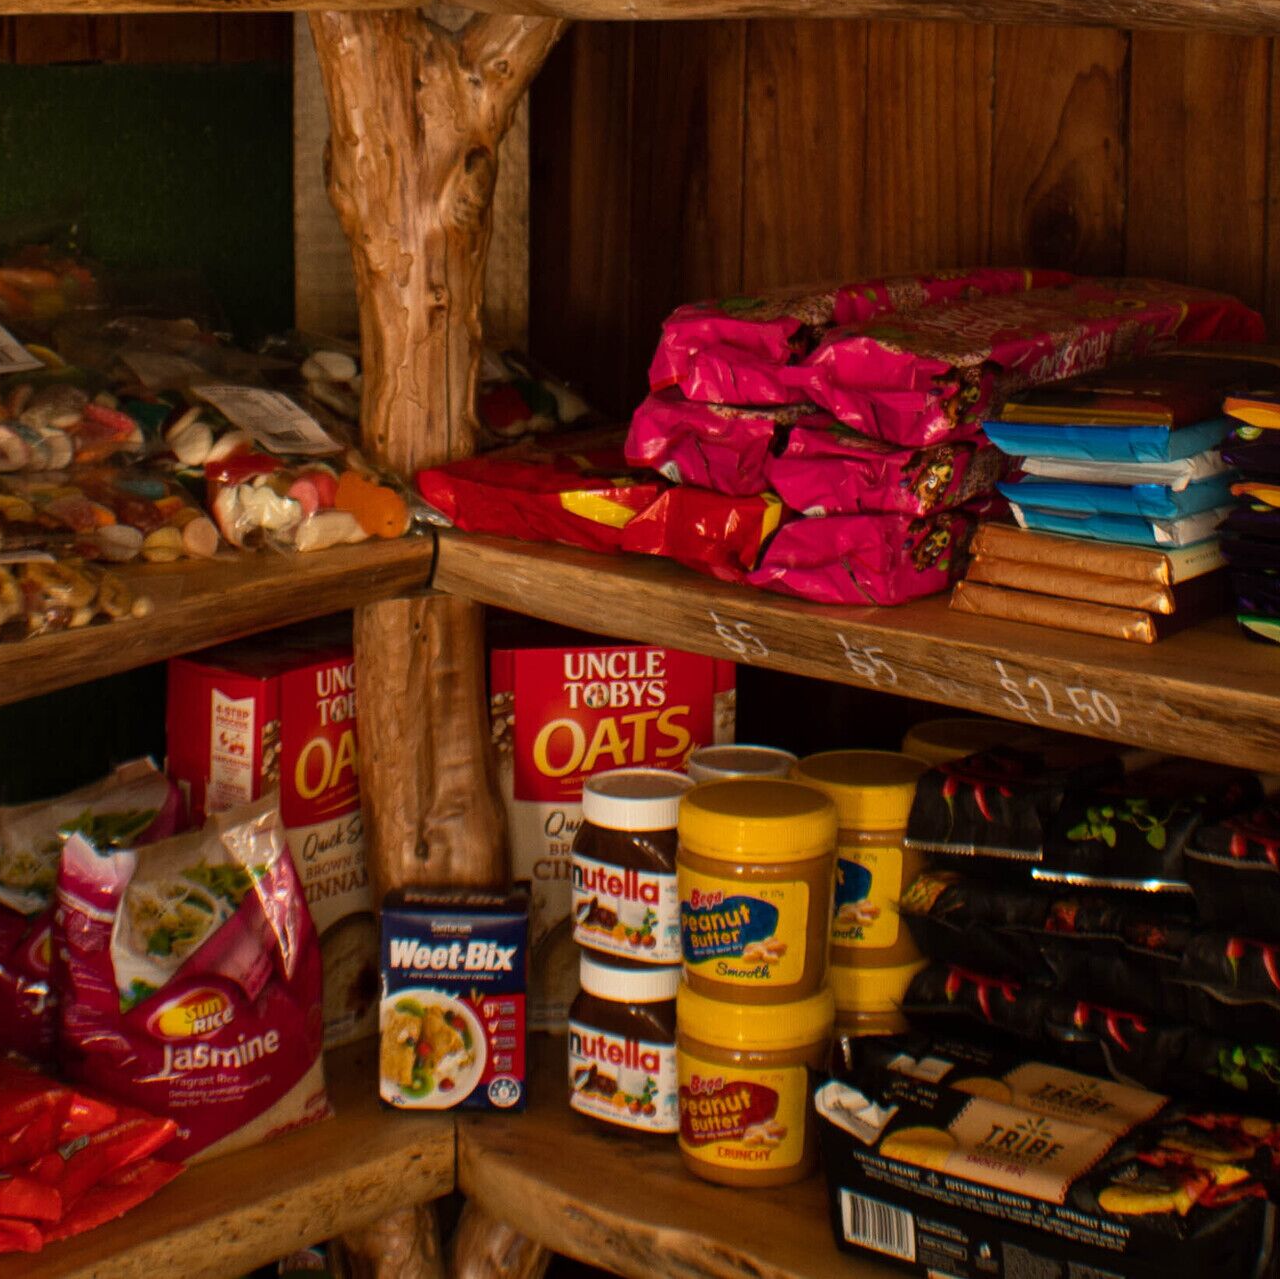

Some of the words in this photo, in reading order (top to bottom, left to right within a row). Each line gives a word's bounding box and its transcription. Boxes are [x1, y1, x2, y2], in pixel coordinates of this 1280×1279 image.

[563, 651, 667, 681] UNCLE
[562, 680, 667, 709] TOBYS
[533, 705, 695, 779] OATS
[573, 861, 661, 906] nutella
[691, 927, 742, 948] Butter
[389, 937, 516, 974] Weet-Bix
[715, 962, 772, 981] Smooth
[192, 1009, 235, 1035] RICE
[160, 1026, 280, 1073] Jasmine
[570, 1029, 661, 1074] nutella
[691, 1113, 742, 1132] Butter
[717, 1146, 772, 1162] CRUNCHY
[983, 1124, 1065, 1159] TRIBE
